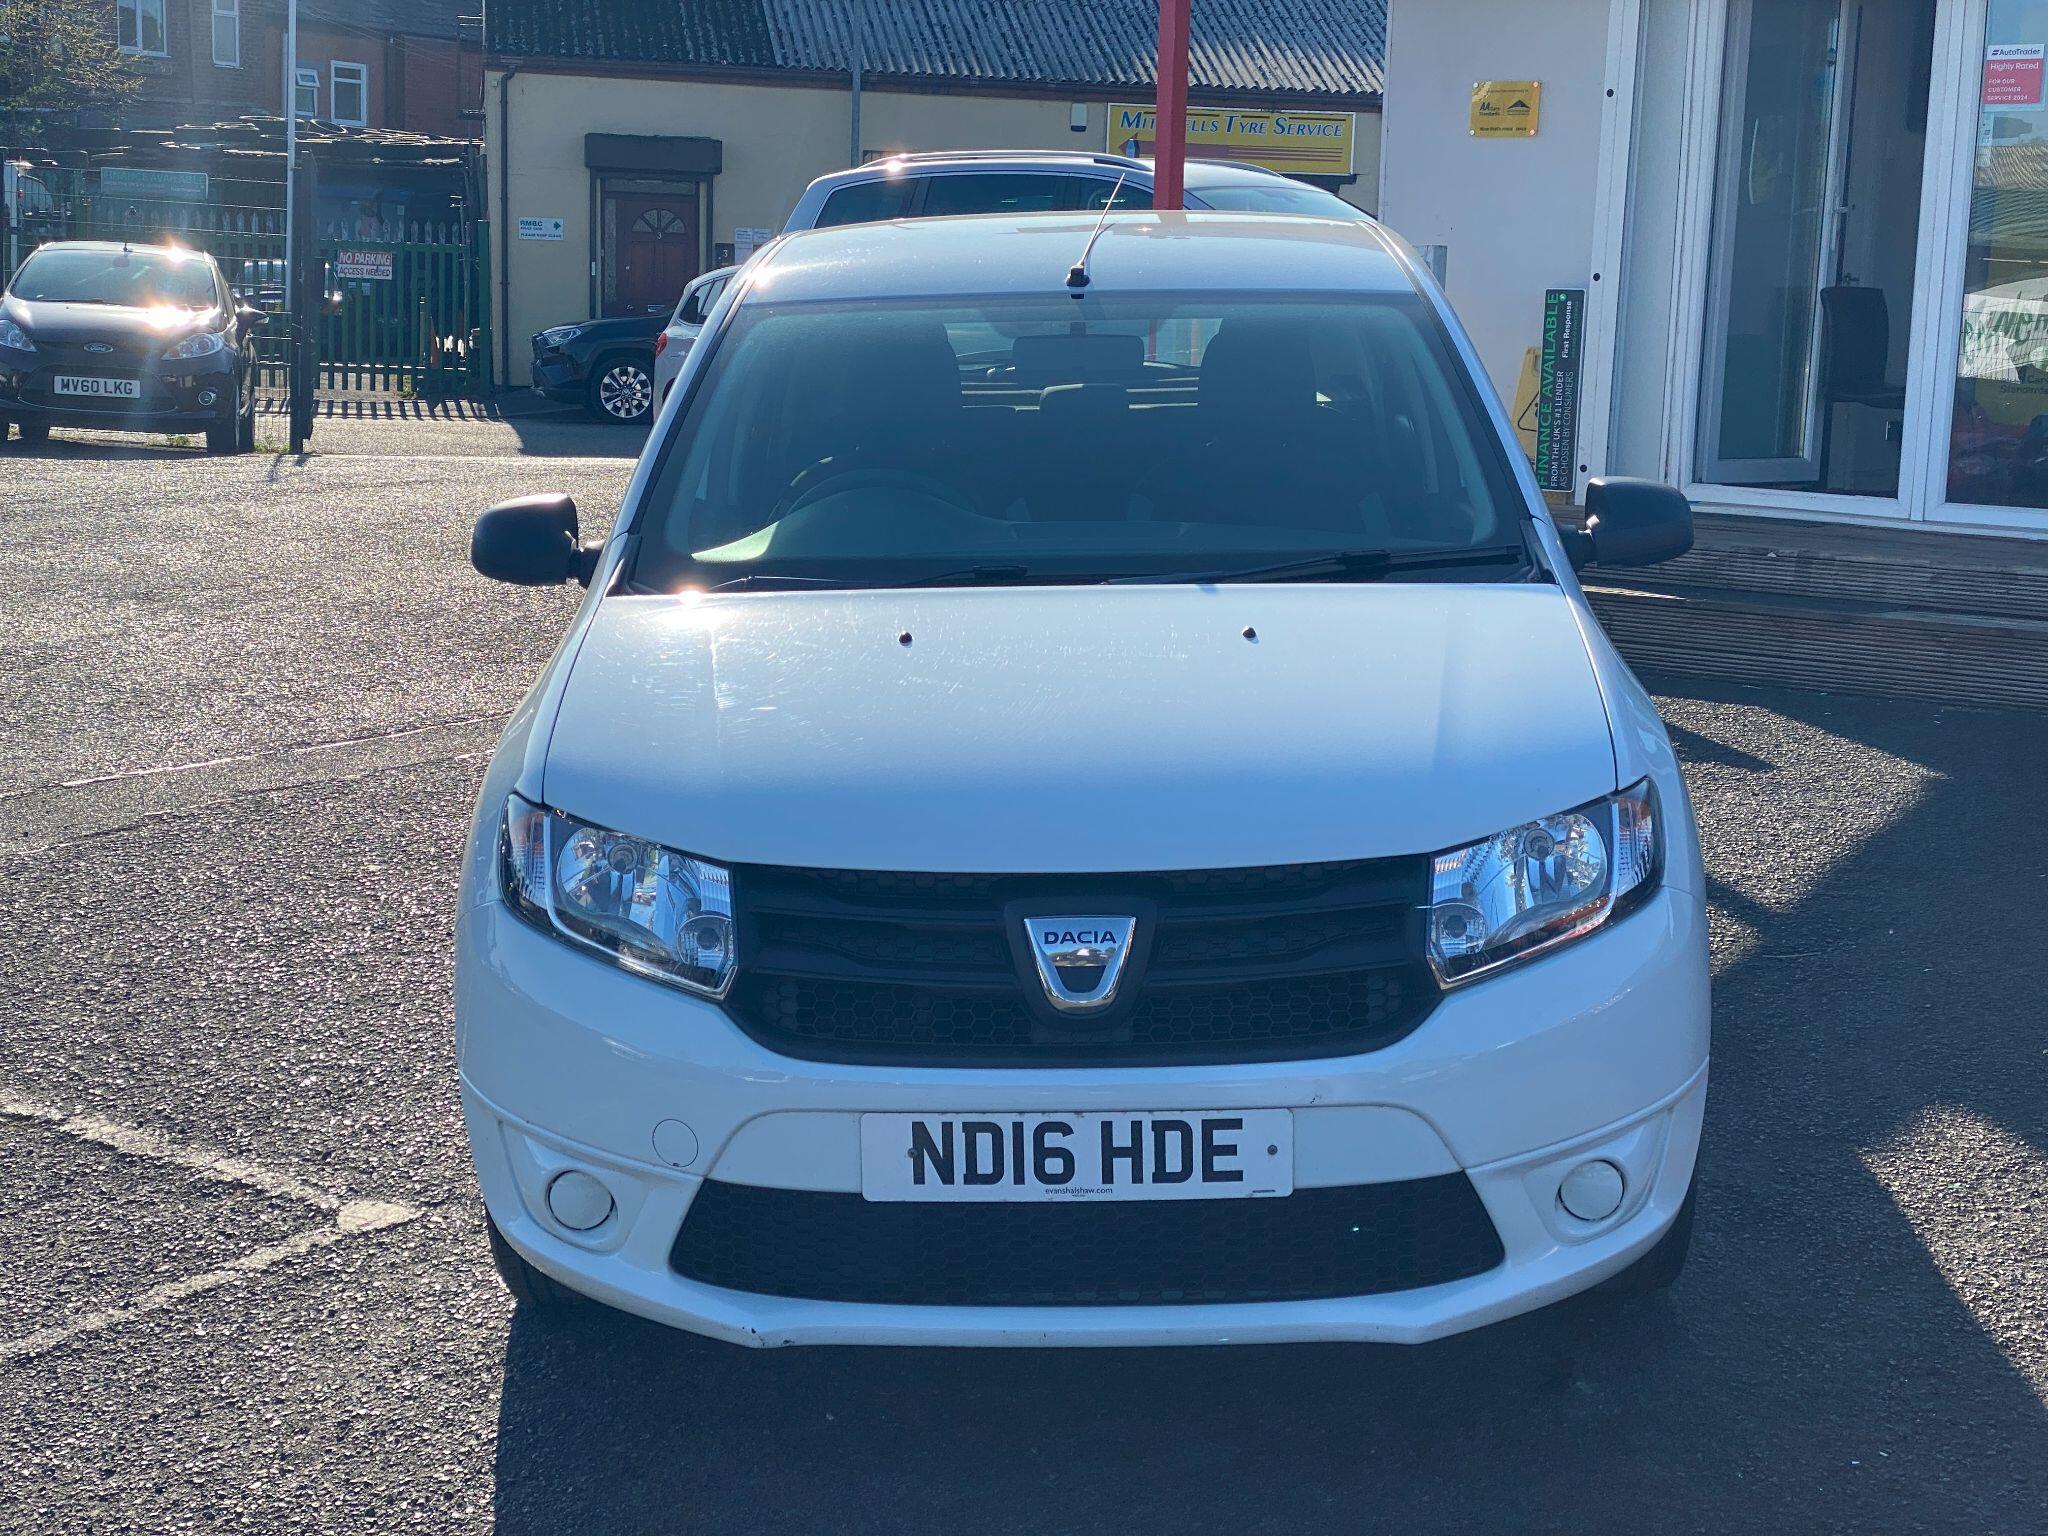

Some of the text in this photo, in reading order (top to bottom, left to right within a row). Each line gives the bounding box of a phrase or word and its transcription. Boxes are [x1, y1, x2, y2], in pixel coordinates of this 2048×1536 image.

[1990, 62, 2039, 72] Highly Rated
[1224, 115, 1268, 134] TYRE
[1273, 116, 1345, 137] SERVICE
[339, 252, 391, 266] NO PARKING
[338, 267, 365, 276] ACCESS
[1562, 301, 1572, 358] First Response
[60, 378, 133, 395] MV60 LKG
[1538, 293, 1559, 486] FINANCE AVAILABLE
[1555, 371, 1564, 406] LENDER
[1553, 420, 1561, 439] UK'S
[1560, 371, 1573, 487] AS CHOSEN BY CONSUMERS
[1552, 442, 1560, 459] THE
[1551, 462, 1559, 487] FROM
[1044, 931, 1116, 944] DACIA
[912, 1118, 1243, 1185] ND16 HDE
[1045, 1187, 1113, 1195] evanshalshaw.com
